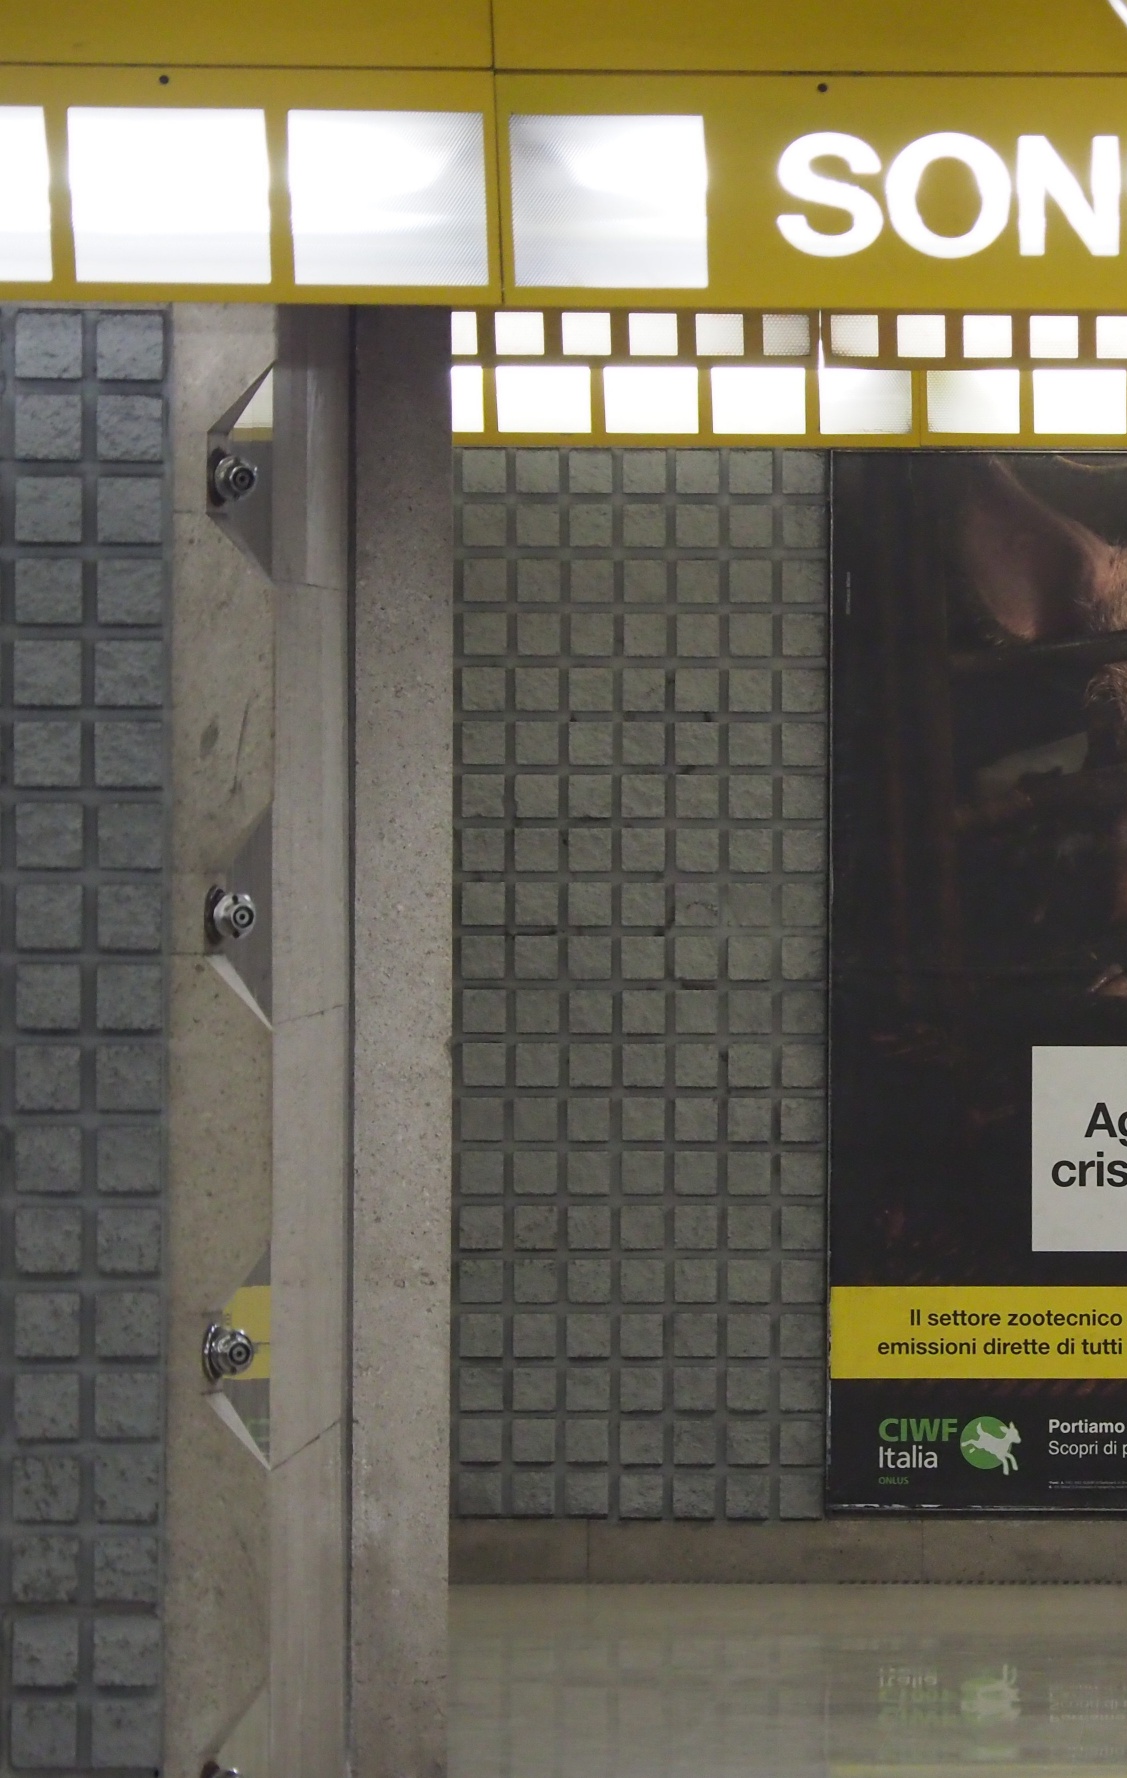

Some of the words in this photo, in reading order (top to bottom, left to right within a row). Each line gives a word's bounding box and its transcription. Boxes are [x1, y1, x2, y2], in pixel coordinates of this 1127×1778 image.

[910, 1309, 921, 1326] Il
[928, 1310, 1001, 1326] settore
[1008, 1309, 1122, 1326] zootecnico
[878, 1338, 976, 1355] emissioni
[984, 1338, 1050, 1355] dirette
[1057, 1338, 1074, 1355] di
[1081, 1338, 1122, 1355] tutti
[879, 1418, 958, 1442] CIWF
[1048, 1418, 1126, 1434] Portiamo
[878, 1444, 938, 1469] Italia
[1048, 1440, 1098, 1459] Scopri
[1103, 1440, 1117, 1455] di
[878, 1476, 909, 1485] ONLUS
